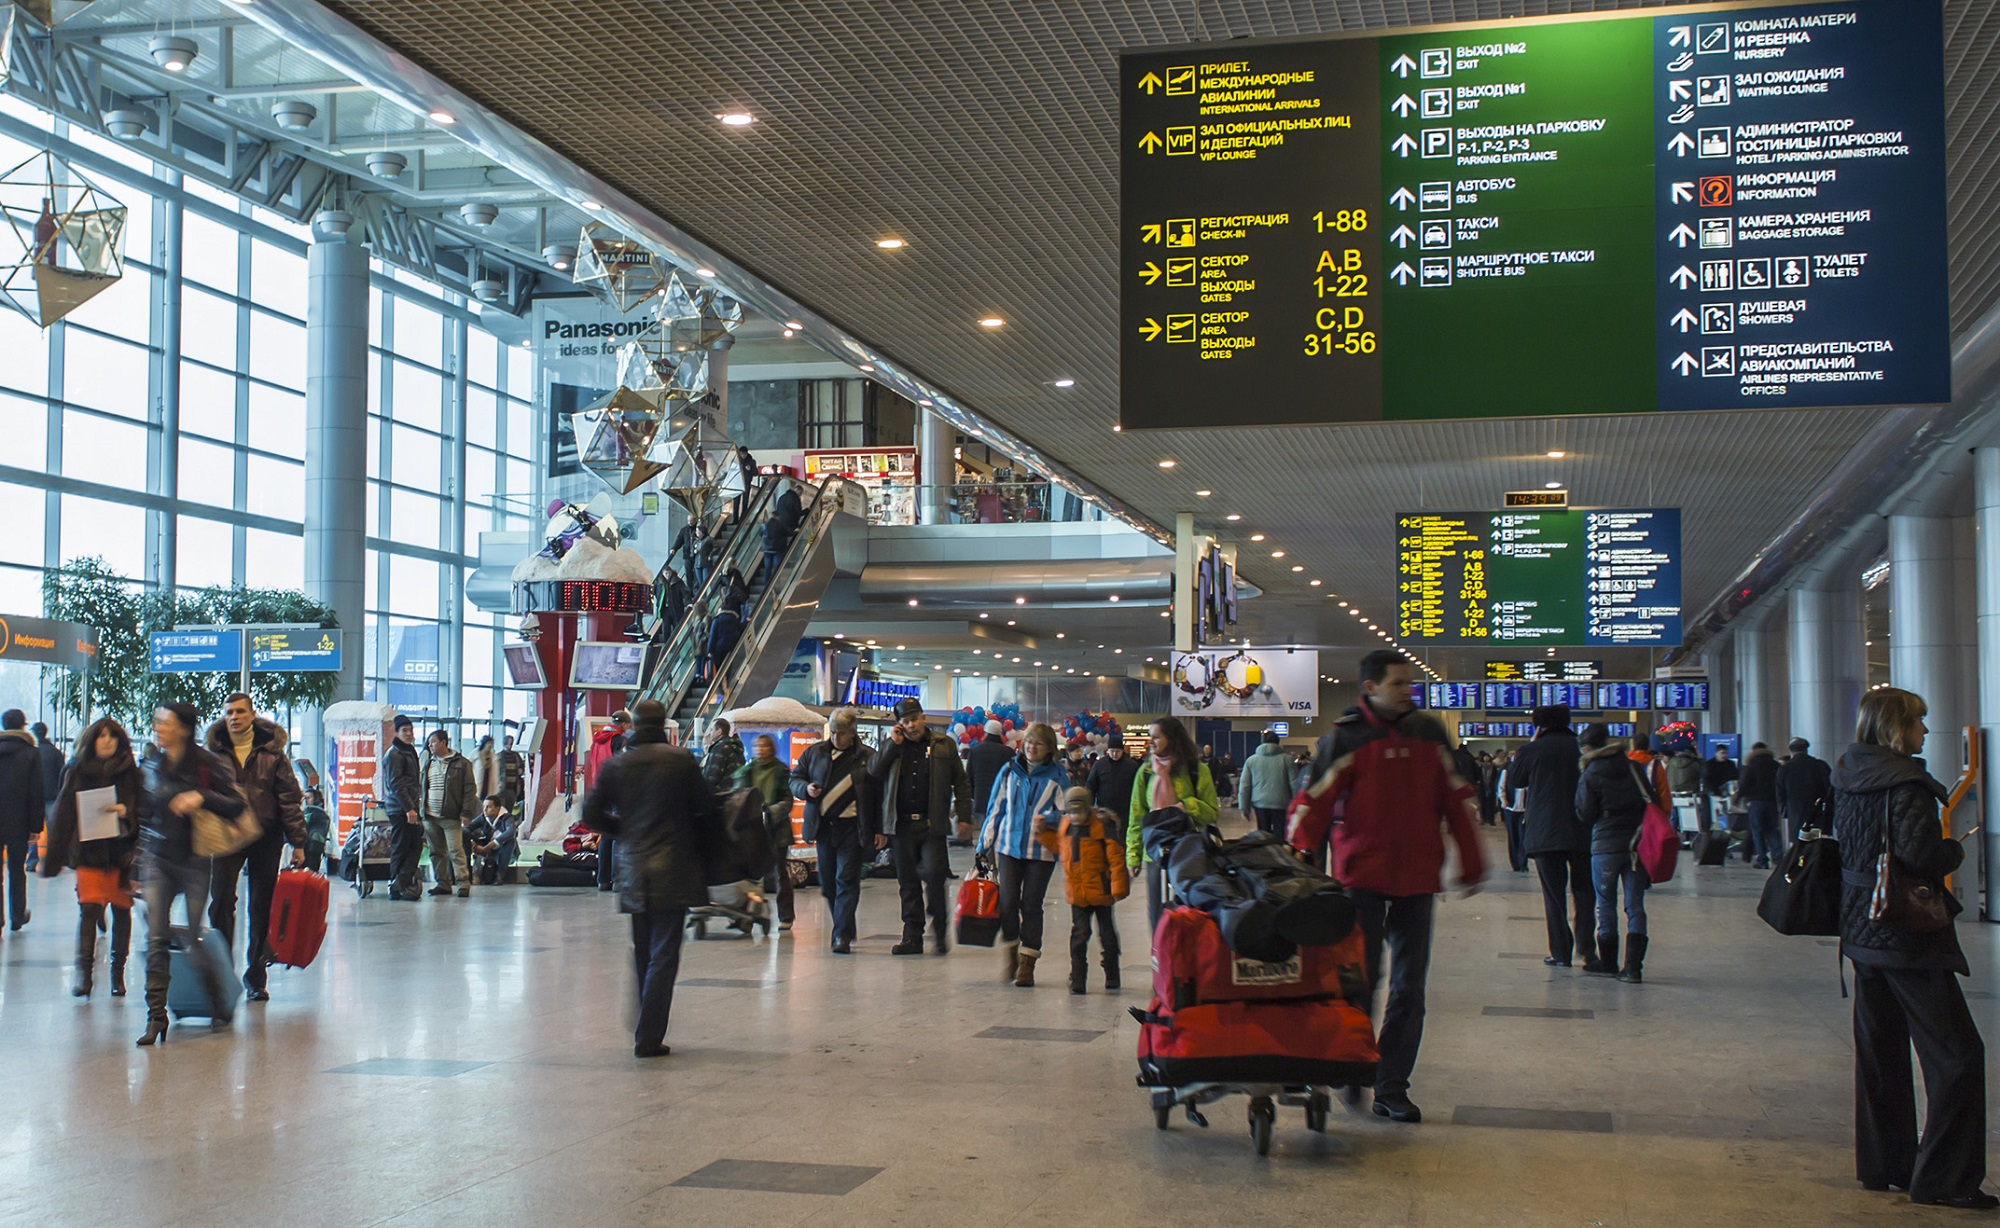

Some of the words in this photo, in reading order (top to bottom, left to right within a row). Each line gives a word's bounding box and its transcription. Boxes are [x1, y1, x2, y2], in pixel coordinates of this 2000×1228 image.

[1734, 16, 1799, 33] КОМНАТА
[1800, 13, 1857, 29] МАТЕРИ
[1734, 36, 1745, 48] И
[1747, 31, 1811, 47] РЕБЕНКА
[1456, 43, 1503, 58] ВЫХОД
[1734, 47, 1786, 61] NURSERY
[1200, 61, 1250, 75] ПРИЛЕТ.
[1456, 59, 1479, 70] EXIT
[1200, 71, 1315, 90] МЕЖДУНАРОДНЫЕ
[1735, 72, 1762, 86] ЗАЛ
[1763, 67, 1845, 84] ОЖИДАНИЯ
[1200, 88, 1276, 104] АВИАЛИНИИ
[1456, 84, 1503, 98] ВЫХОД
[1737, 85, 1782, 98] WAITING
[1783, 82, 1829, 95] LOUNGE
[1200, 102, 1273, 115] INTERNATIONAL
[1274, 98, 1321, 111] ARRIVALS
[1456, 99, 1479, 110] EXIT
[1200, 123, 1224, 136] ЗАЛ
[1226, 117, 1323, 135] ОФИЦИАЛЬНЫХ
[1324, 116, 1351, 129] ЛИЦ
[1456, 124, 1515, 140] ВЫХОДЫ
[1516, 122, 1535, 136] НА
[1536, 119, 1606, 135] ПАРКОВКУ
[1735, 119, 1854, 139] АДМИНИСТРАТОР
[1169, 134, 1194, 148] VIP
[1200, 138, 1209, 150] И
[1210, 132, 1284, 151] ДЕЛЕГАЦИЙ
[1736, 135, 1821, 153] ГОСТИНИЦЫ
[1829, 131, 1902, 148] ПАРКОВКИ
[1200, 151, 1215, 162] VIP
[1216, 149, 1256, 160] LOUNGE
[1456, 154, 1501, 166] PARKING
[1502, 151, 1558, 164] ENTRANCE
[1736, 153, 1771, 165] HOTEL
[1776, 150, 1823, 163] PARKING
[1823, 145, 1909, 160] ADMINISTRATOR
[1456, 178, 1516, 193] АВТОБУС
[1737, 169, 1836, 187] ИНФОРМАЦИЯ
[1456, 194, 1478, 204] BUS
[1737, 186, 1817, 201] INFORMATION
[1200, 213, 1289, 229] РЕГИСТРАЦИЯ
[1312, 209, 1368, 233] 1-88
[1456, 217, 1499, 230] ТАКСИ
[1738, 213, 1793, 228] КАМЕРА
[1794, 210, 1871, 225] ХРАНЕНИЯ
[1200, 229, 1246, 240] CHECK-IN
[1456, 231, 1479, 241] TAXI
[1738, 228, 1792, 240] BAGGAGE
[1792, 226, 1845, 238] STORAGE
[600, 253, 649, 263] MARTINI
[1200, 255, 1249, 267] СЕКТОР
[1316, 249, 1362, 275] A,B
[1456, 252, 1549, 268] МАРШРУТНОЕ
[1550, 250, 1595, 263] ТАКСИ
[1813, 253, 1867, 268] ТУАЛЕТ
[1200, 269, 1227, 279] AREA
[1456, 267, 1502, 278] SHUTTLE
[1503, 266, 1525, 276] BUS
[1814, 266, 1859, 279] TOILETS
[1200, 280, 1255, 293] ВЫХОДЫ
[1312, 274, 1368, 298] 1-22
[1200, 293, 1232, 303] GATES
[1738, 300, 1806, 317] ДУШЕВАЯ
[1200, 311, 1250, 324] СЕКТОР
[1315, 307, 1364, 333] C,D
[1738, 313, 1794, 325] SHOWERS
[545, 316, 662, 339] Panasonic
[1200, 326, 1227, 336] AREA
[560, 344, 598, 356] ideas
[1200, 336, 1255, 350] ВЫХОДЫ
[1304, 332, 1376, 356] 31-56
[1739, 340, 1893, 358] ПРЕДСТАВИТЕЛЬСТВА
[1200, 349, 1232, 360] GATES
[1739, 355, 1855, 373] АВИАКОМПАНИЙ
[1740, 373, 1789, 385] AIRLINES
[1789, 371, 1884, 384] REPRESENTATIVE
[1741, 385, 1787, 396] OFFICES
[317, 641, 335, 650] 1-22
[1288, 701, 1312, 710] VISA
[339, 765, 345, 787] 5
